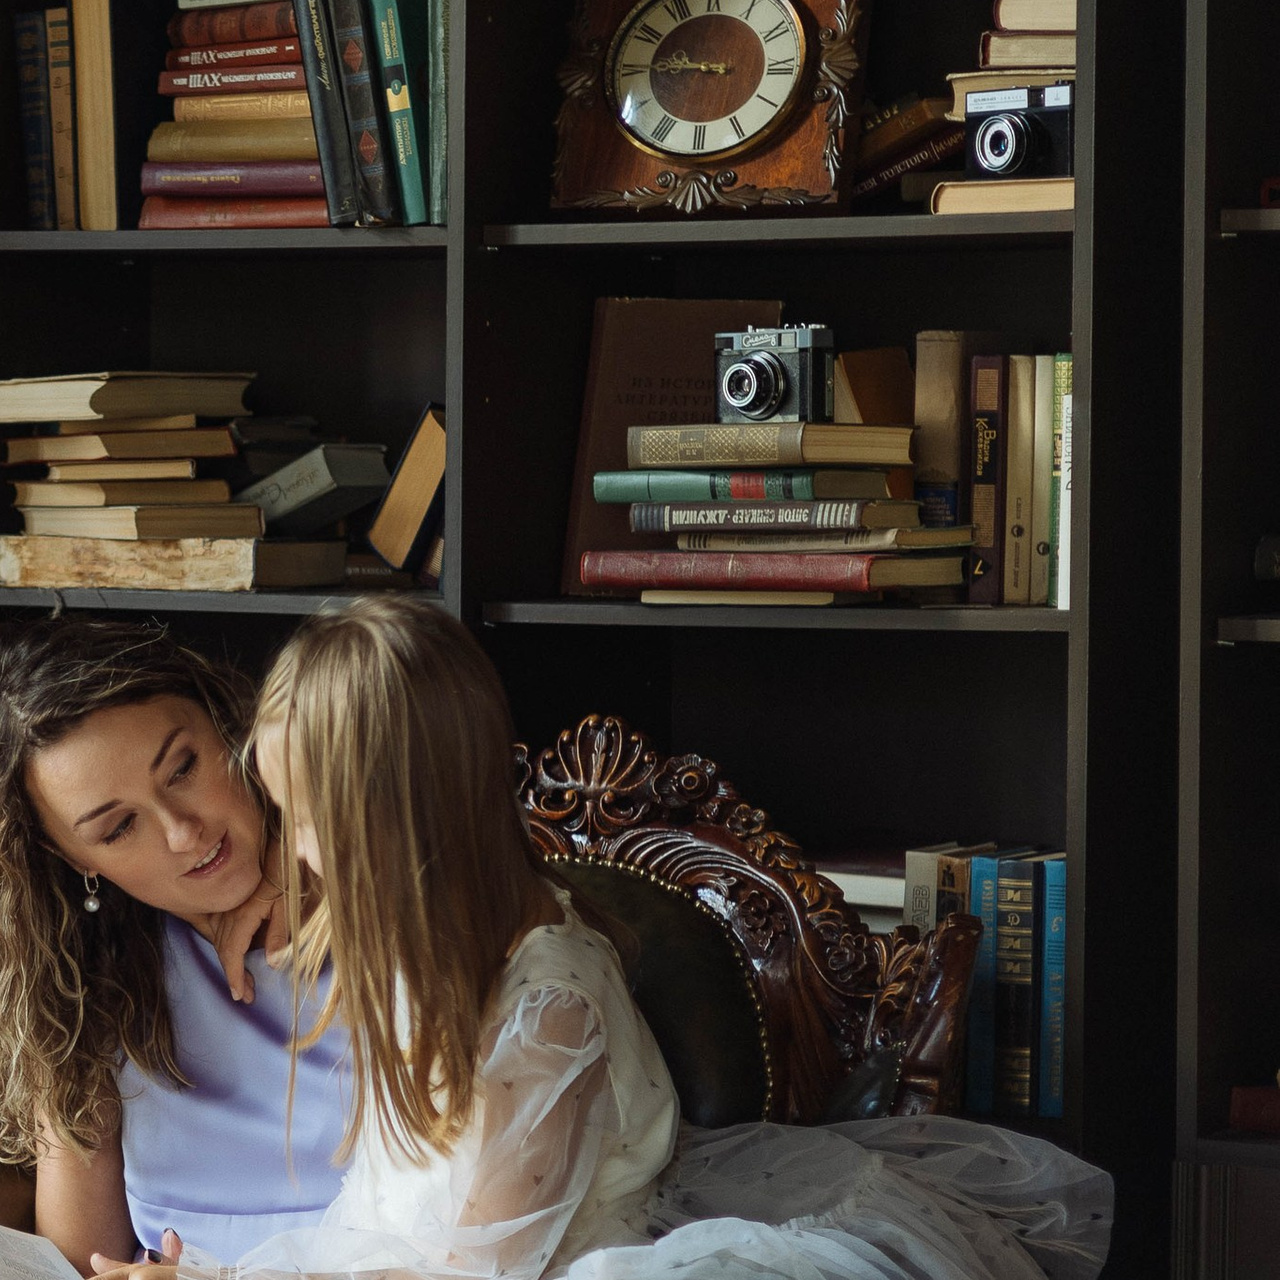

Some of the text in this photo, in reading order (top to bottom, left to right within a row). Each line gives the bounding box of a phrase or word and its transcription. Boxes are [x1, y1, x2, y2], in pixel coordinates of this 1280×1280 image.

[634, 23, 663, 45] VII
[760, 20, 789, 43] XI
[189, 49, 217, 65] XVIII
[766, 58, 795, 75] XII
[187, 72, 221, 88] XVIII
[651, 114, 677, 143] IIII
[693, 125, 706, 150] III
[729, 116, 745, 139] II
[616, 394, 713, 405] ЛИТЕРАТУР
[973, 417, 988, 476] Кожевников
[982, 429, 996, 463] Вадим
[778, 507, 809, 523] ЭПТОН
